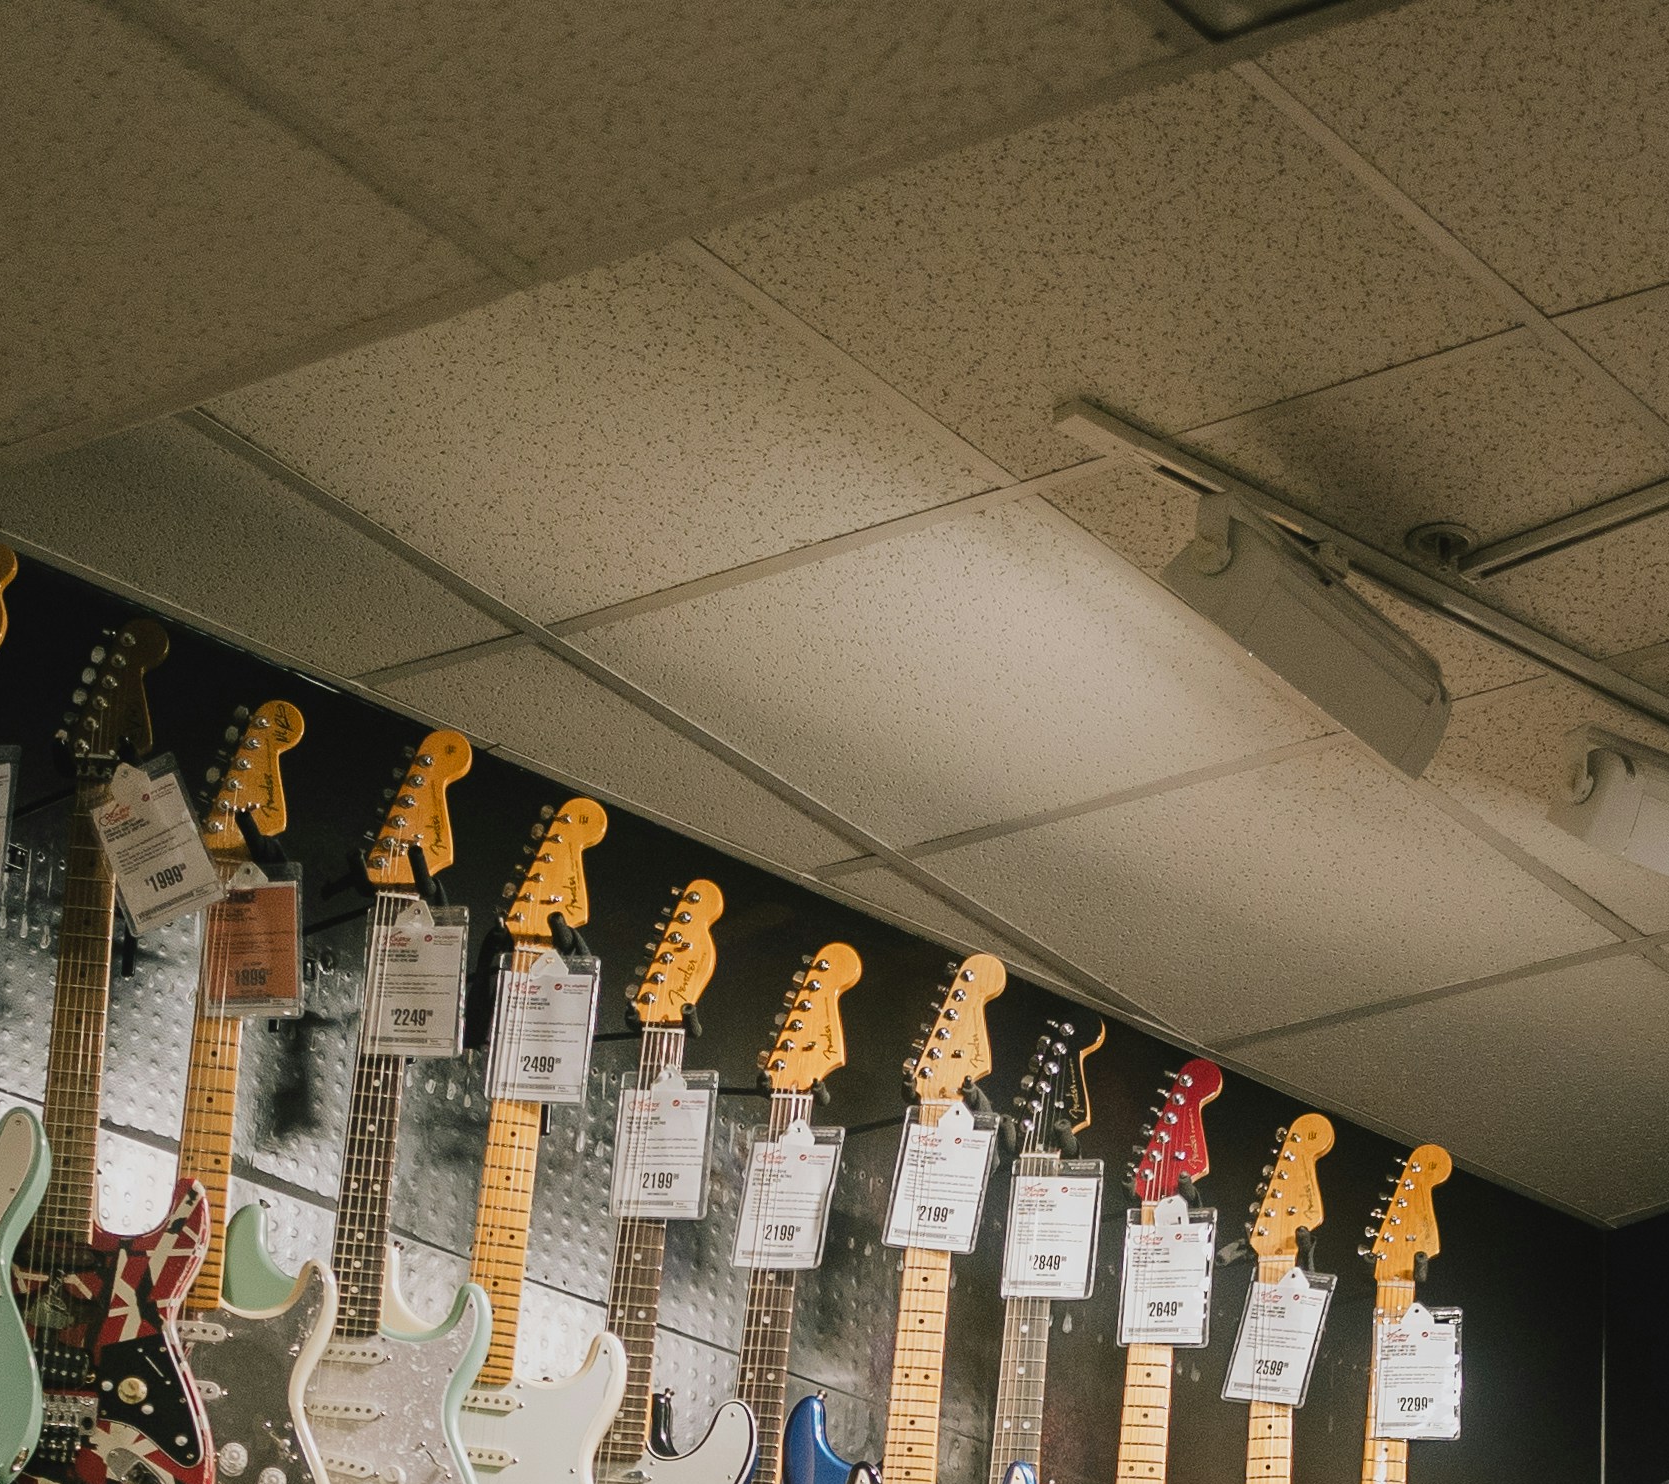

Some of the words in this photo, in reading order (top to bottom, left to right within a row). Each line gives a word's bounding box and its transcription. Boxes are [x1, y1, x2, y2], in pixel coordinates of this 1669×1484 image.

[565, 876, 583, 916] Fender
[667, 960, 698, 1005] Fender
[822, 1025, 837, 1061] Fender
